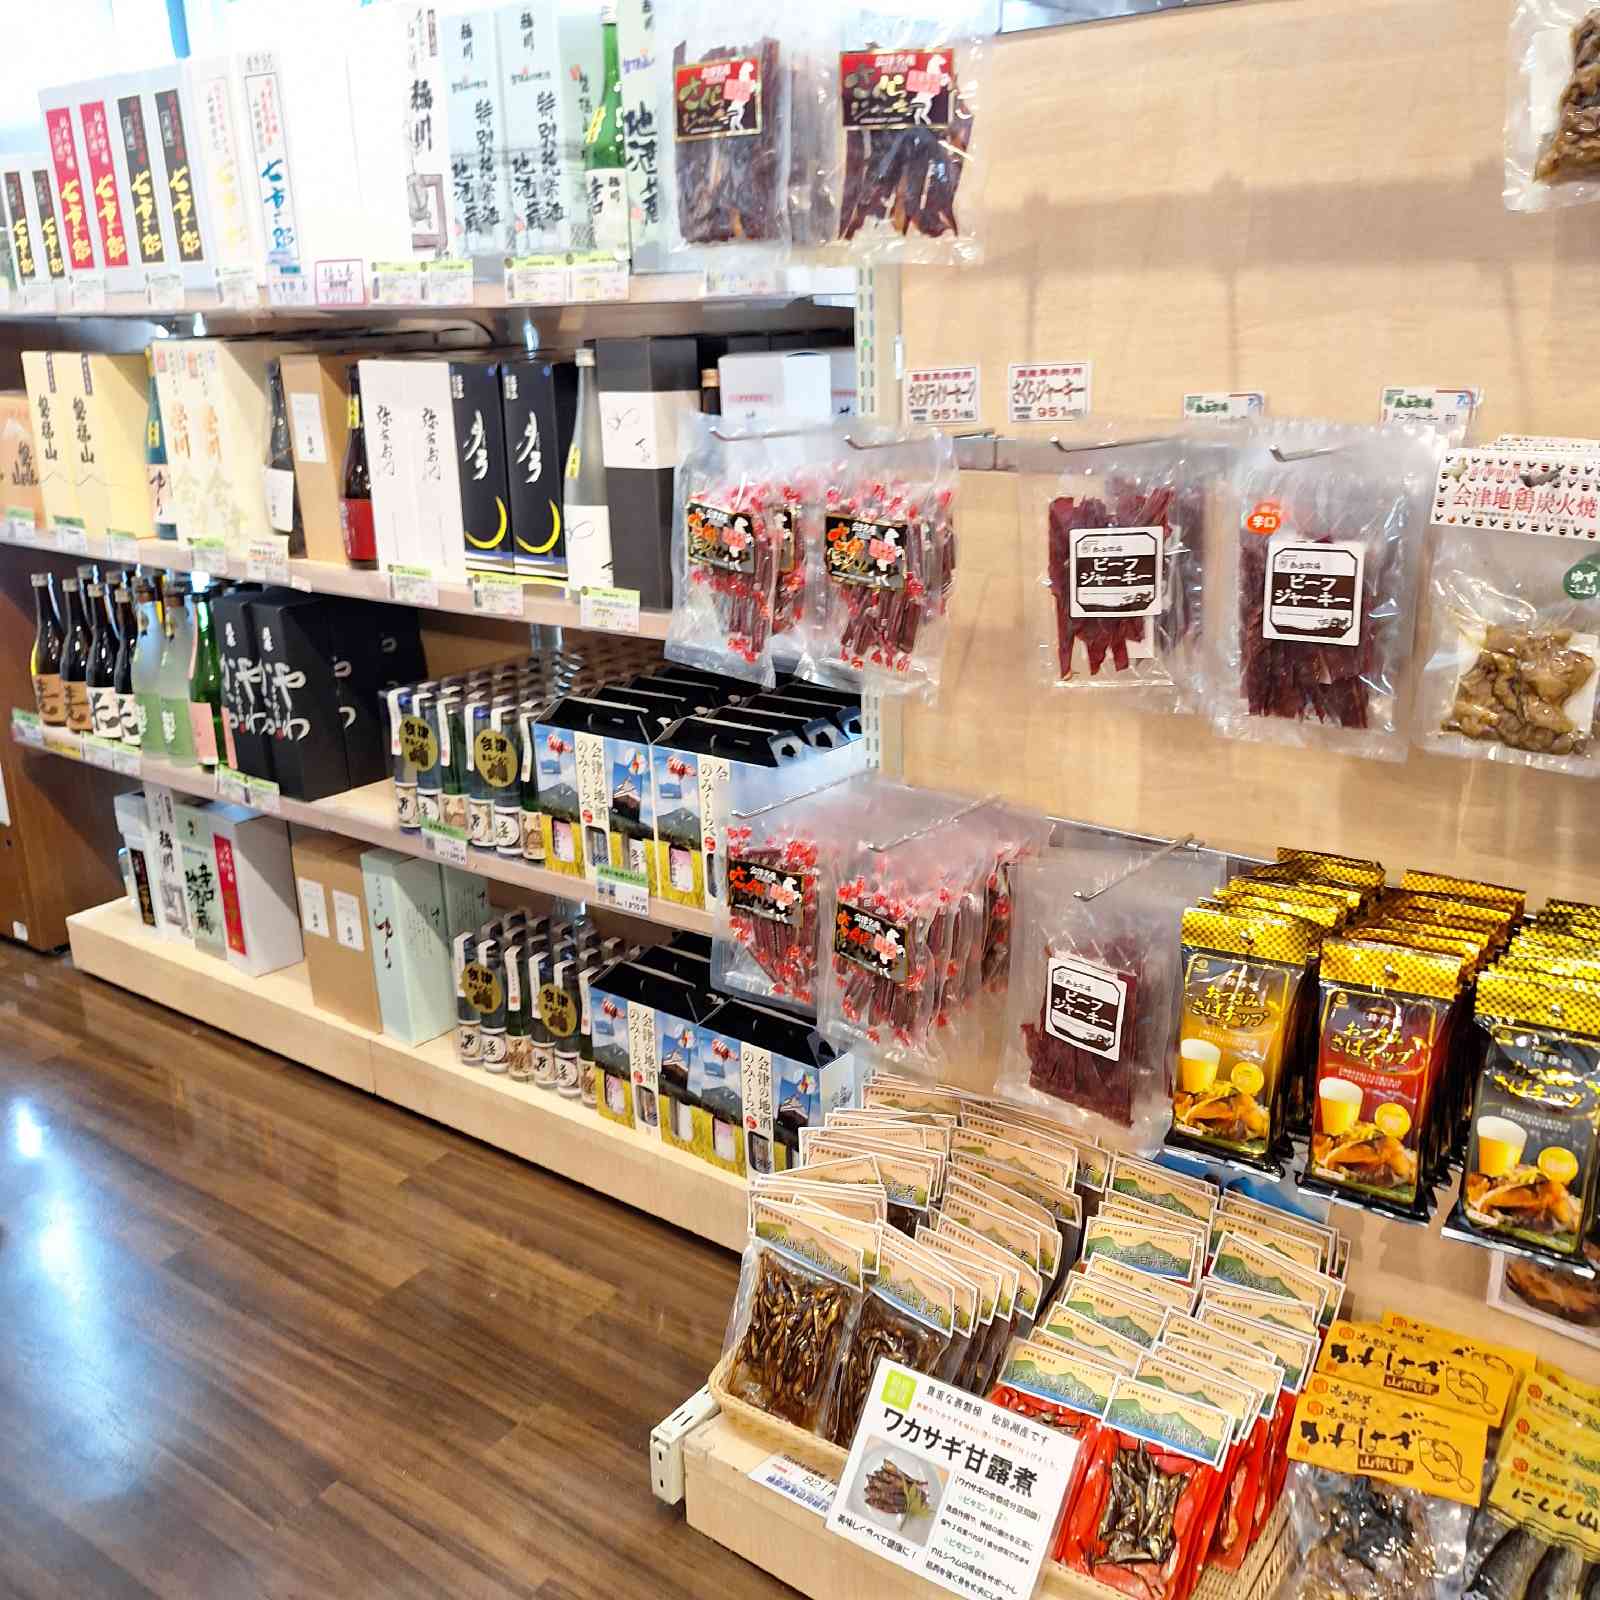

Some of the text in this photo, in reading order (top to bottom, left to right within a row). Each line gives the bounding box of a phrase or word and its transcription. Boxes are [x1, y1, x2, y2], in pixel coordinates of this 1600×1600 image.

[1094, 557, 1139, 571] ビーフ
[1080, 571, 1153, 586] ジャーキー
[1290, 574, 1337, 592] ビーフ
[1274, 588, 1351, 608] ジャーキー
[1065, 990, 1104, 1011] ビーフ
[1053, 997, 1113, 1026] ジャーキー
[884, 1407, 1039, 1499] ワカサギ甘露煮
